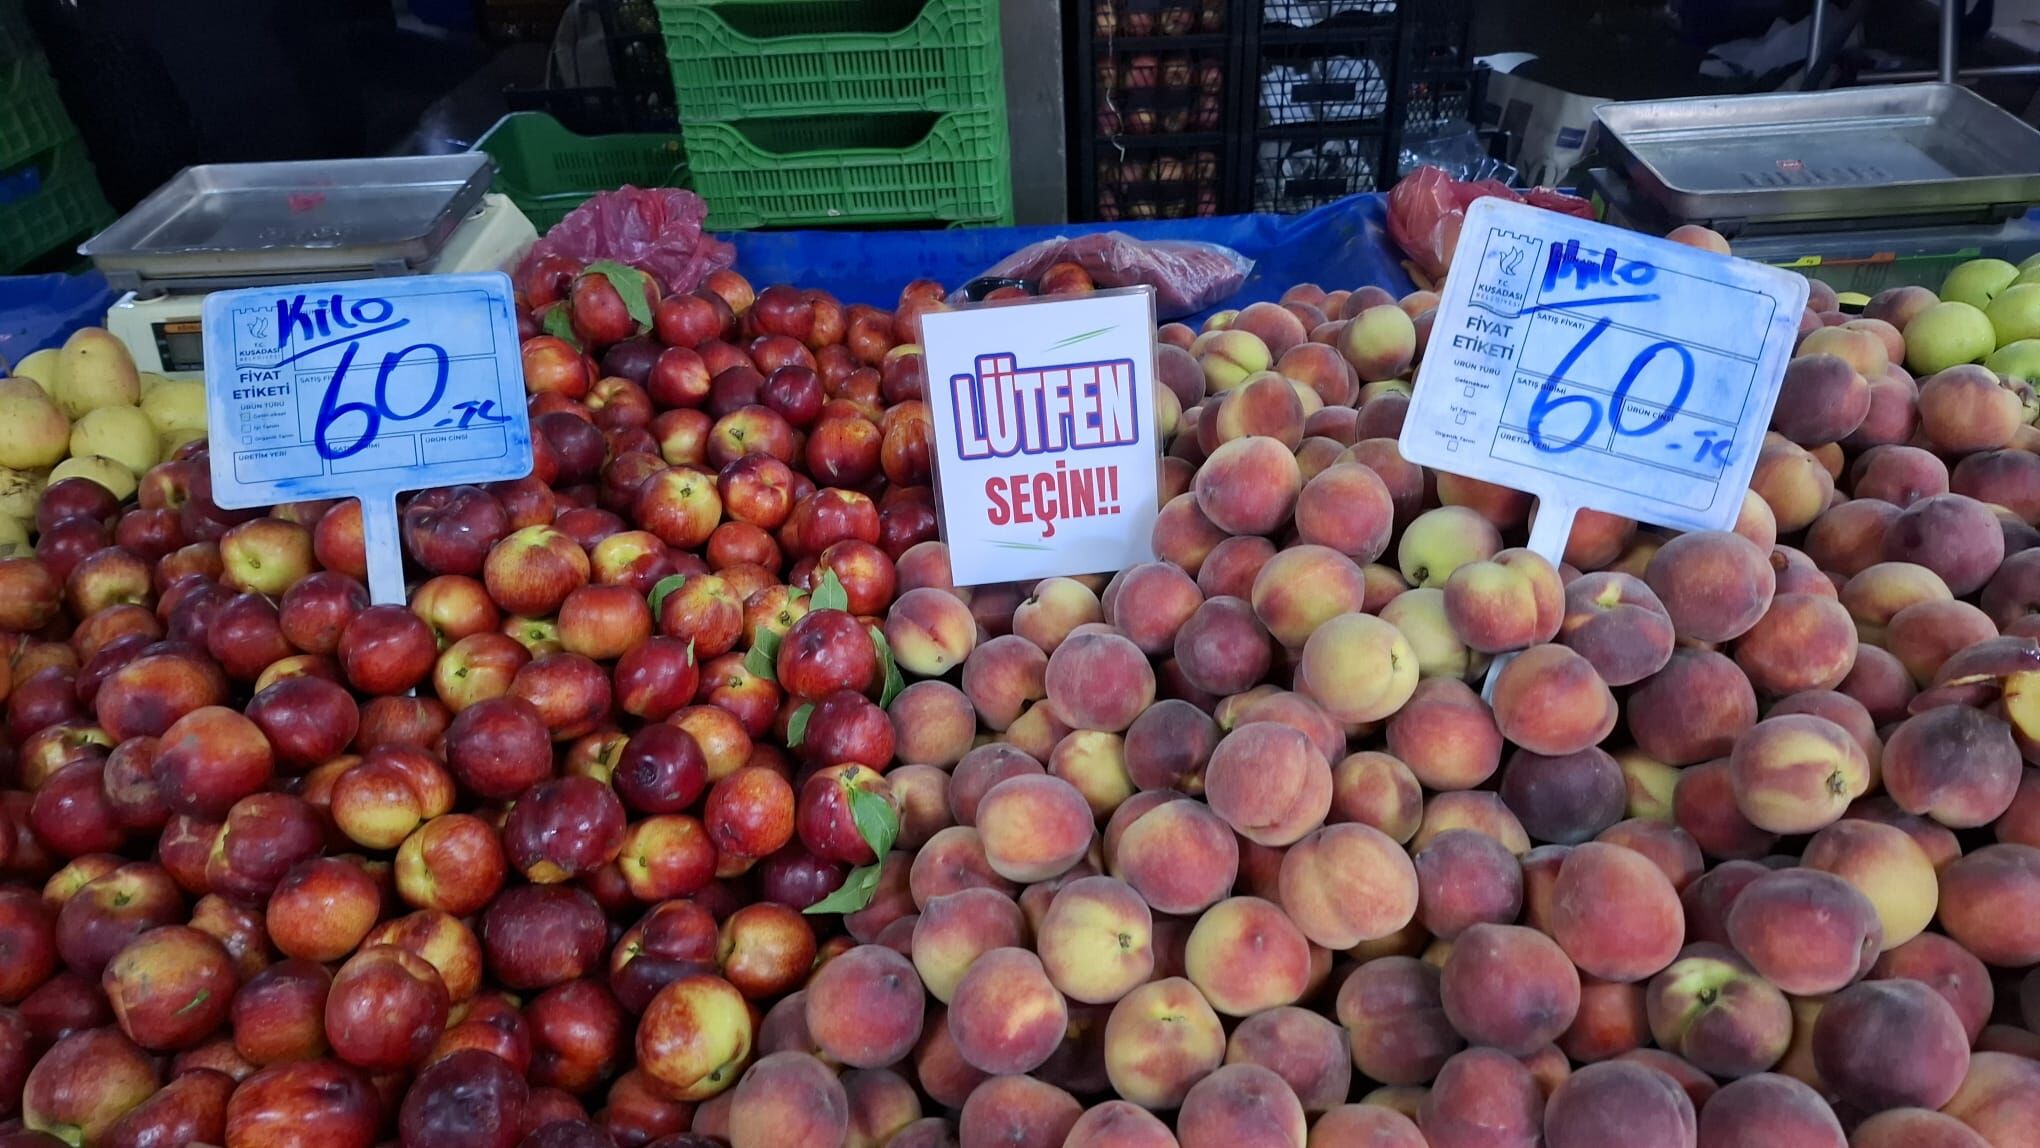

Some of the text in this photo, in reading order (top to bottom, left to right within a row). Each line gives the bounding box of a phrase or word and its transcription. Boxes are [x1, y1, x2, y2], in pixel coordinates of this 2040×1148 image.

[1543, 239, 1658, 293] Kilo
[1478, 284, 1523, 300] KUŞADASI
[277, 294, 394, 348] Kilo
[1466, 315, 1513, 338] FİYAT
[1537, 312, 1559, 323] SATIŞ
[1452, 335, 1514, 360] ETİKETİ
[240, 370, 281, 383] FİYAT
[1516, 377, 1539, 389] SATIŞ
[1527, 316, 1696, 454] 60
[233, 382, 290, 400] ETİKETİ
[315, 341, 449, 459] 60
[951, 353, 1139, 460] LÜTFEN
[1627, 404, 1650, 417] ÜRÜN
[985, 459, 1121, 537] SEÇİN!!
